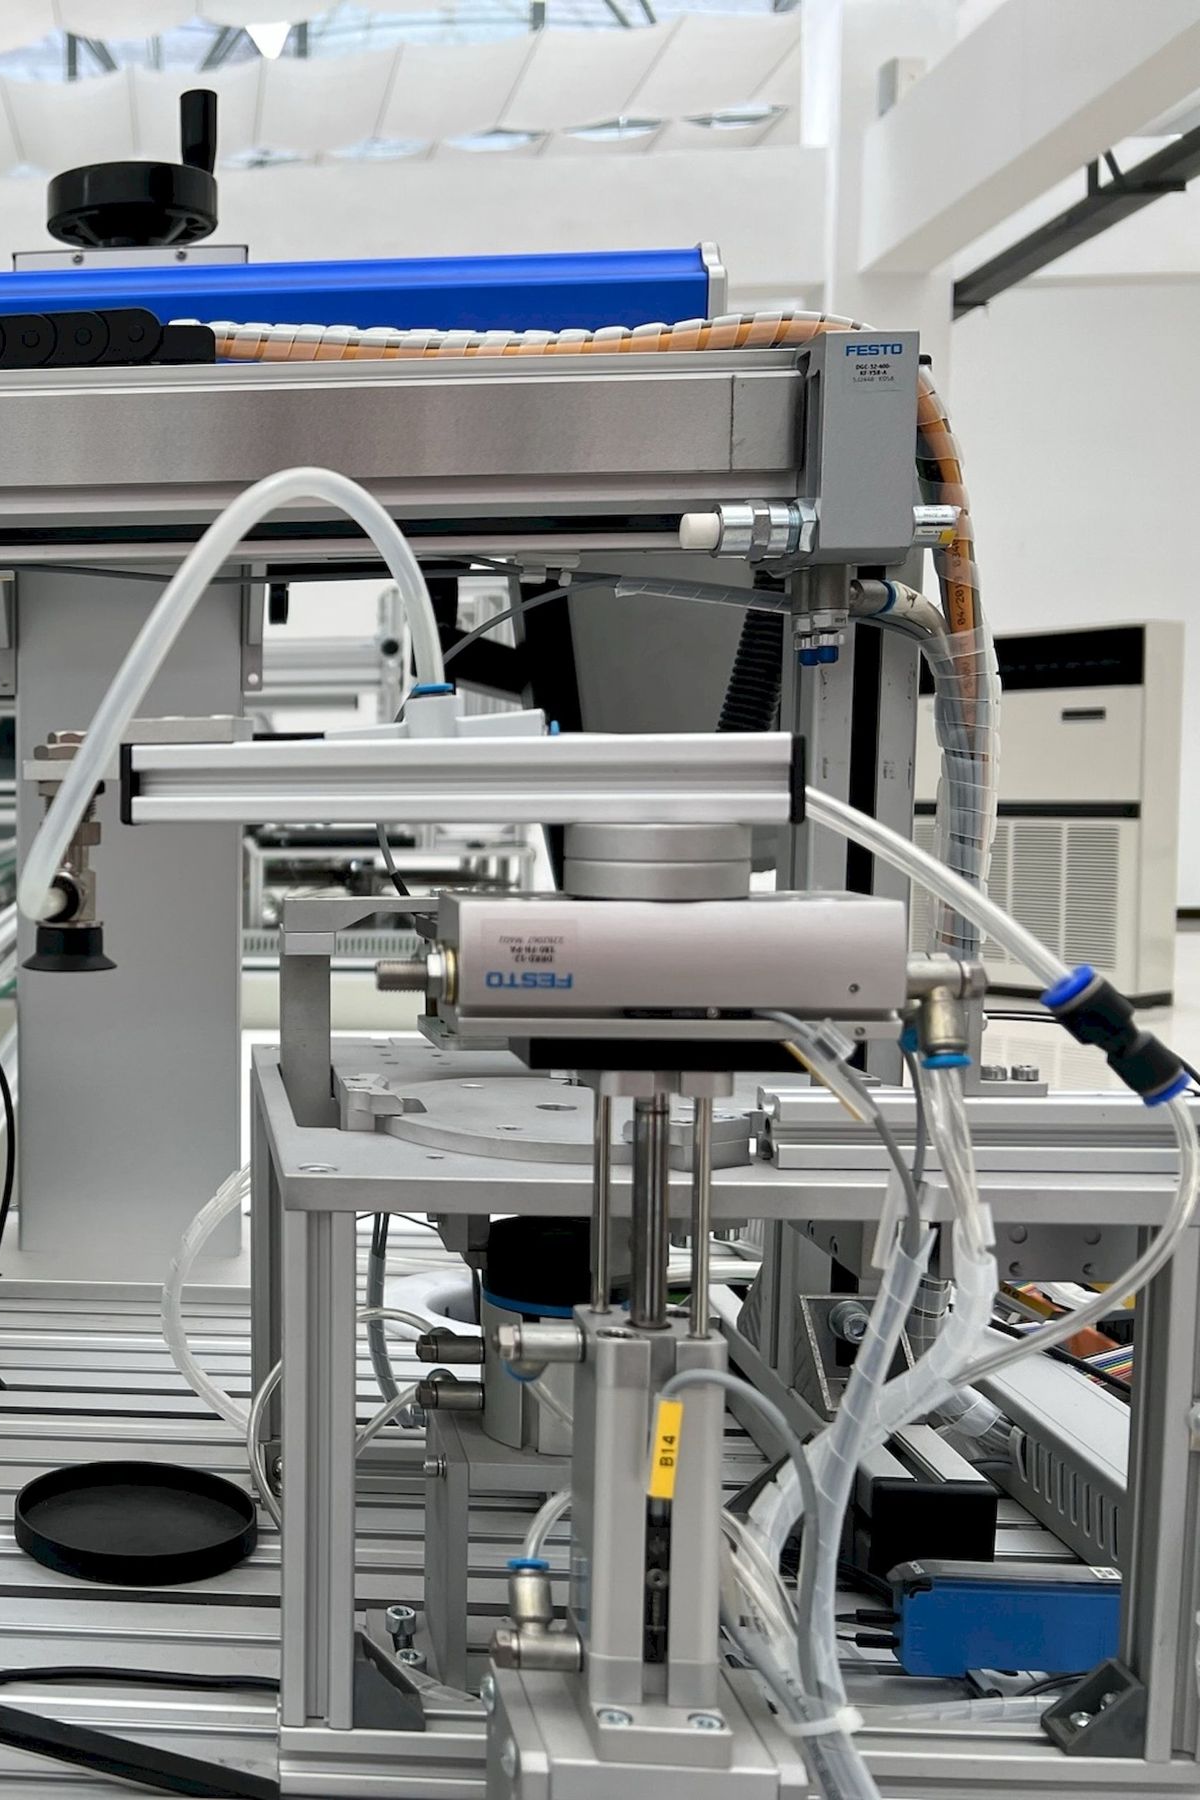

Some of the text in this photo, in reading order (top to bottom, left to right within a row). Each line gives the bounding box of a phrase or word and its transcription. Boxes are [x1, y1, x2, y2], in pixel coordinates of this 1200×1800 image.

[845, 343, 903, 357] FESTO
[485, 971, 574, 989] FESTO
[659, 1435, 676, 1467] B14
